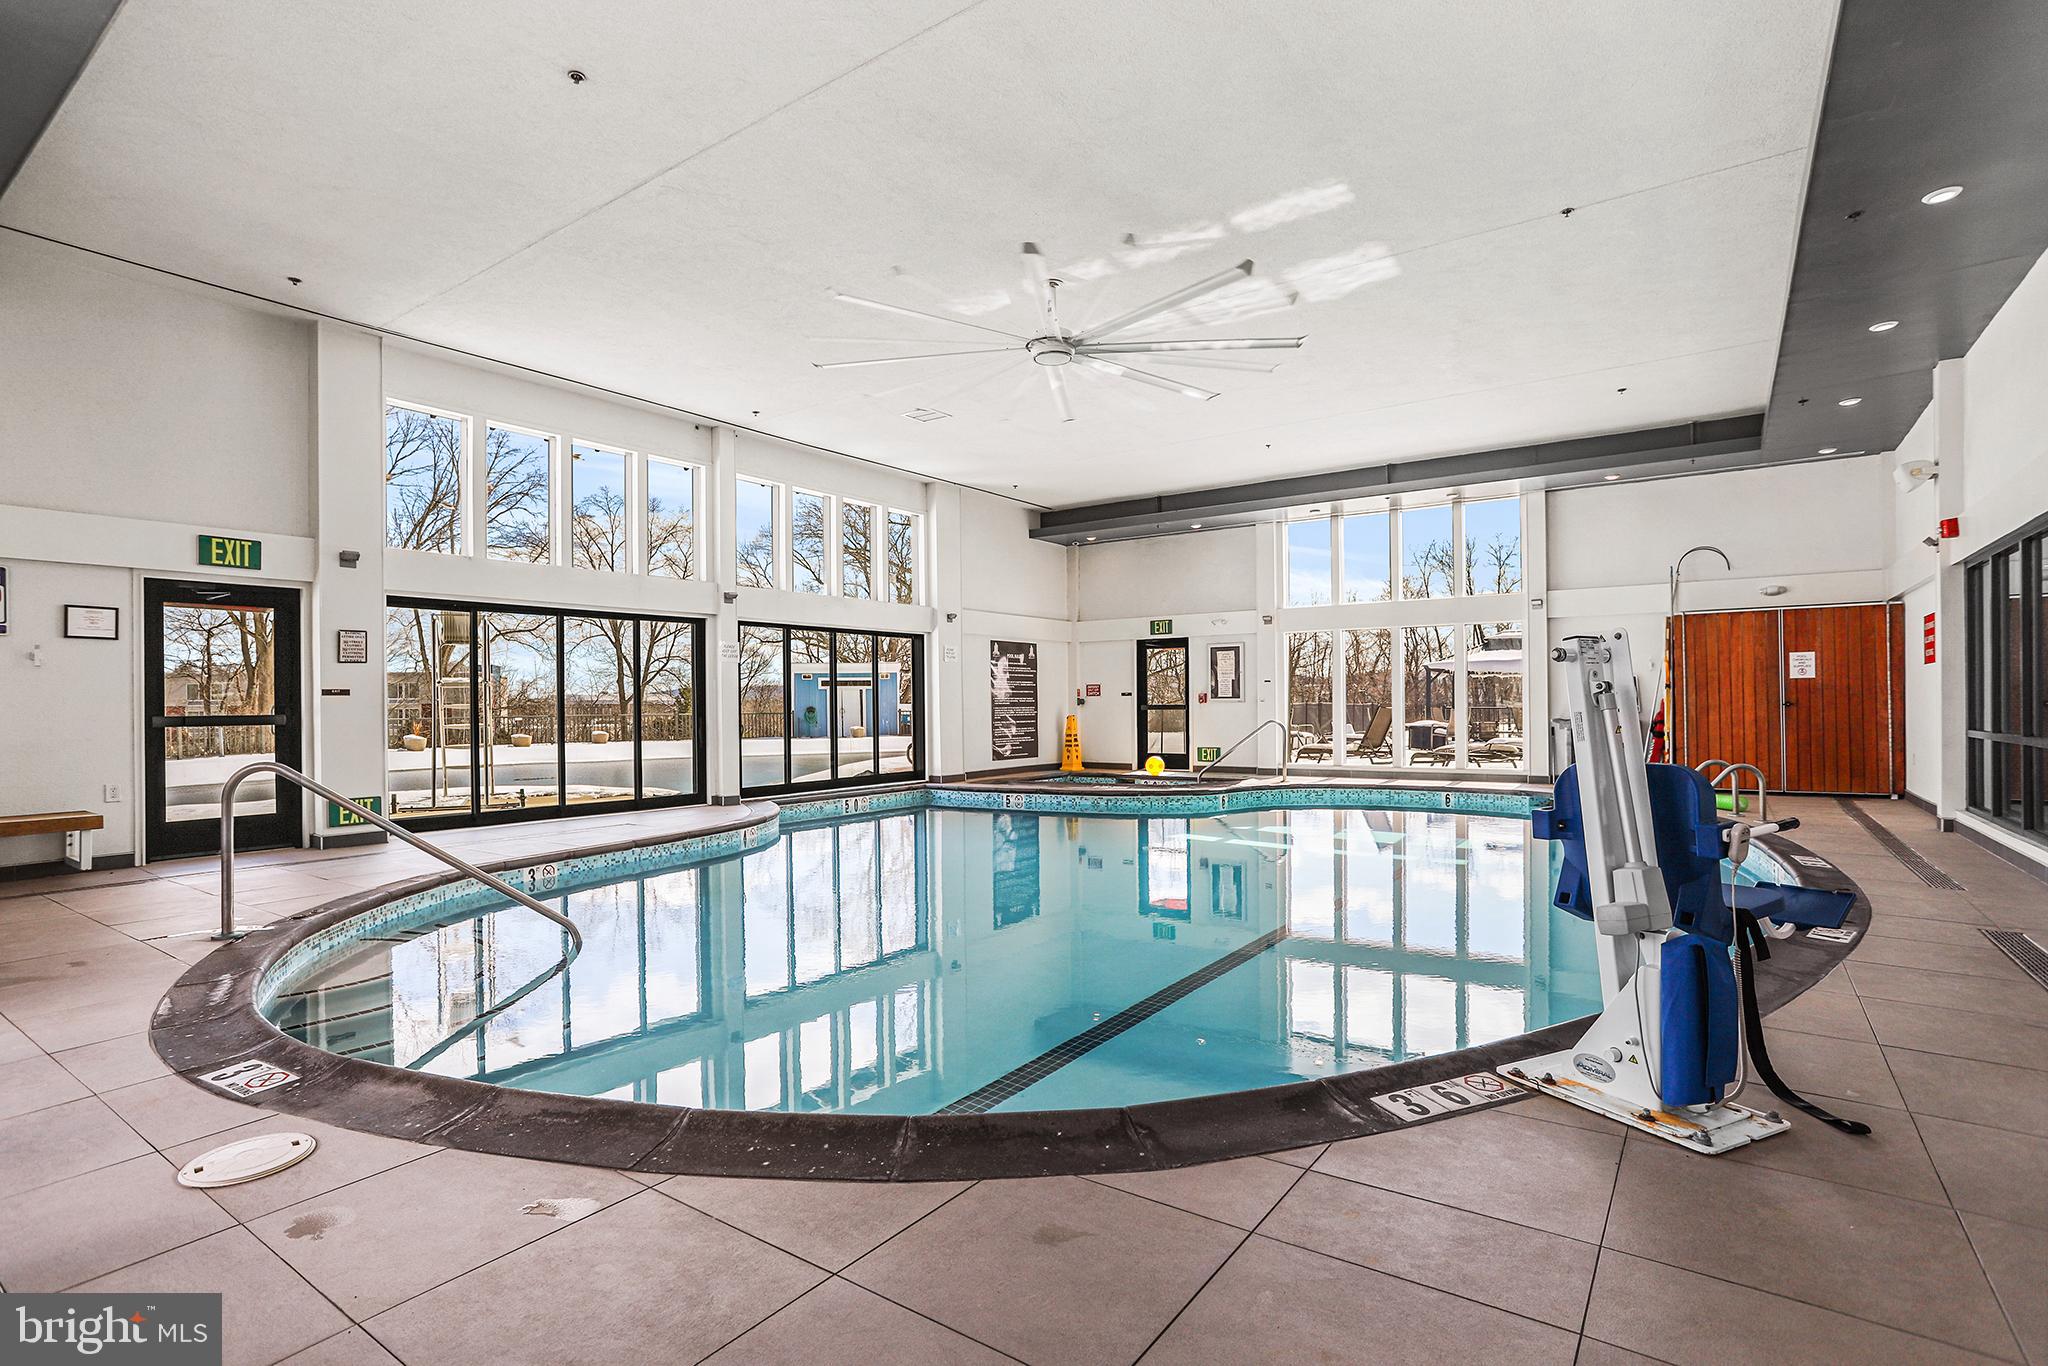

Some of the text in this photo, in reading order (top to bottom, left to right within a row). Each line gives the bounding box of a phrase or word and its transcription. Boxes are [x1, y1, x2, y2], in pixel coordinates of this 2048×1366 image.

[211, 537, 252, 567] EXIT
[1154, 620, 1169, 634] EXIT
[1202, 748, 1218, 761] EXIT
[211, 1063, 263, 1081] 3
[1388, 1093, 1431, 1116] 3
[1429, 1084, 1472, 1106] 6
